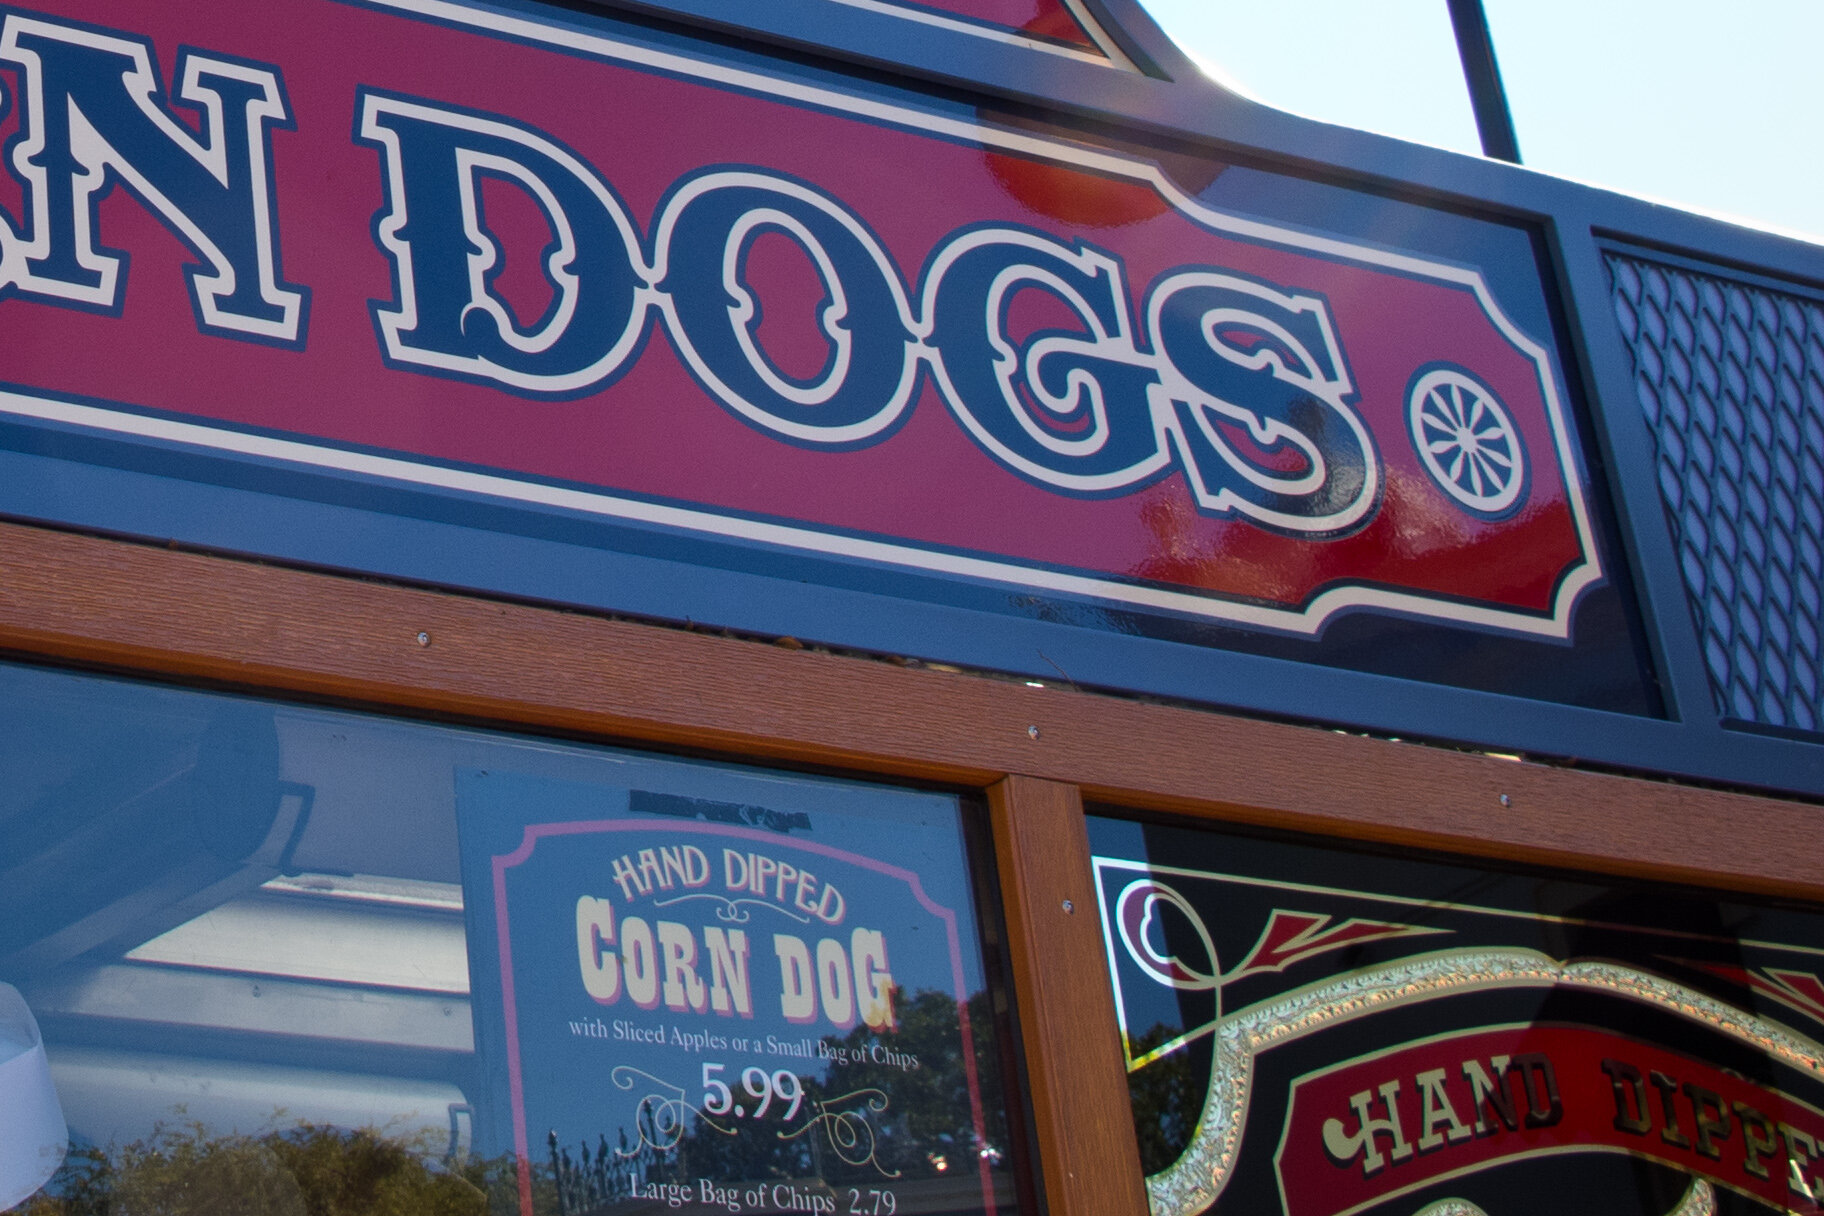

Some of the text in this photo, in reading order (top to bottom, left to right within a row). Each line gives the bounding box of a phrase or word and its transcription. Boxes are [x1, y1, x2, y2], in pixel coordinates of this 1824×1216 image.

[353, 85, 1382, 540] DOGS
[612, 845, 845, 925] HAND DIPPED
[576, 894, 897, 1032] CORN DOG
[568, 1017, 920, 1071] with Sliced Apples or a Small Bag of Chips
[702, 1062, 806, 1121] 5.99
[1322, 1052, 1824, 1199] HAND DIPPE
[629, 1172, 897, 1216] Large Bag of Chips 2.79
